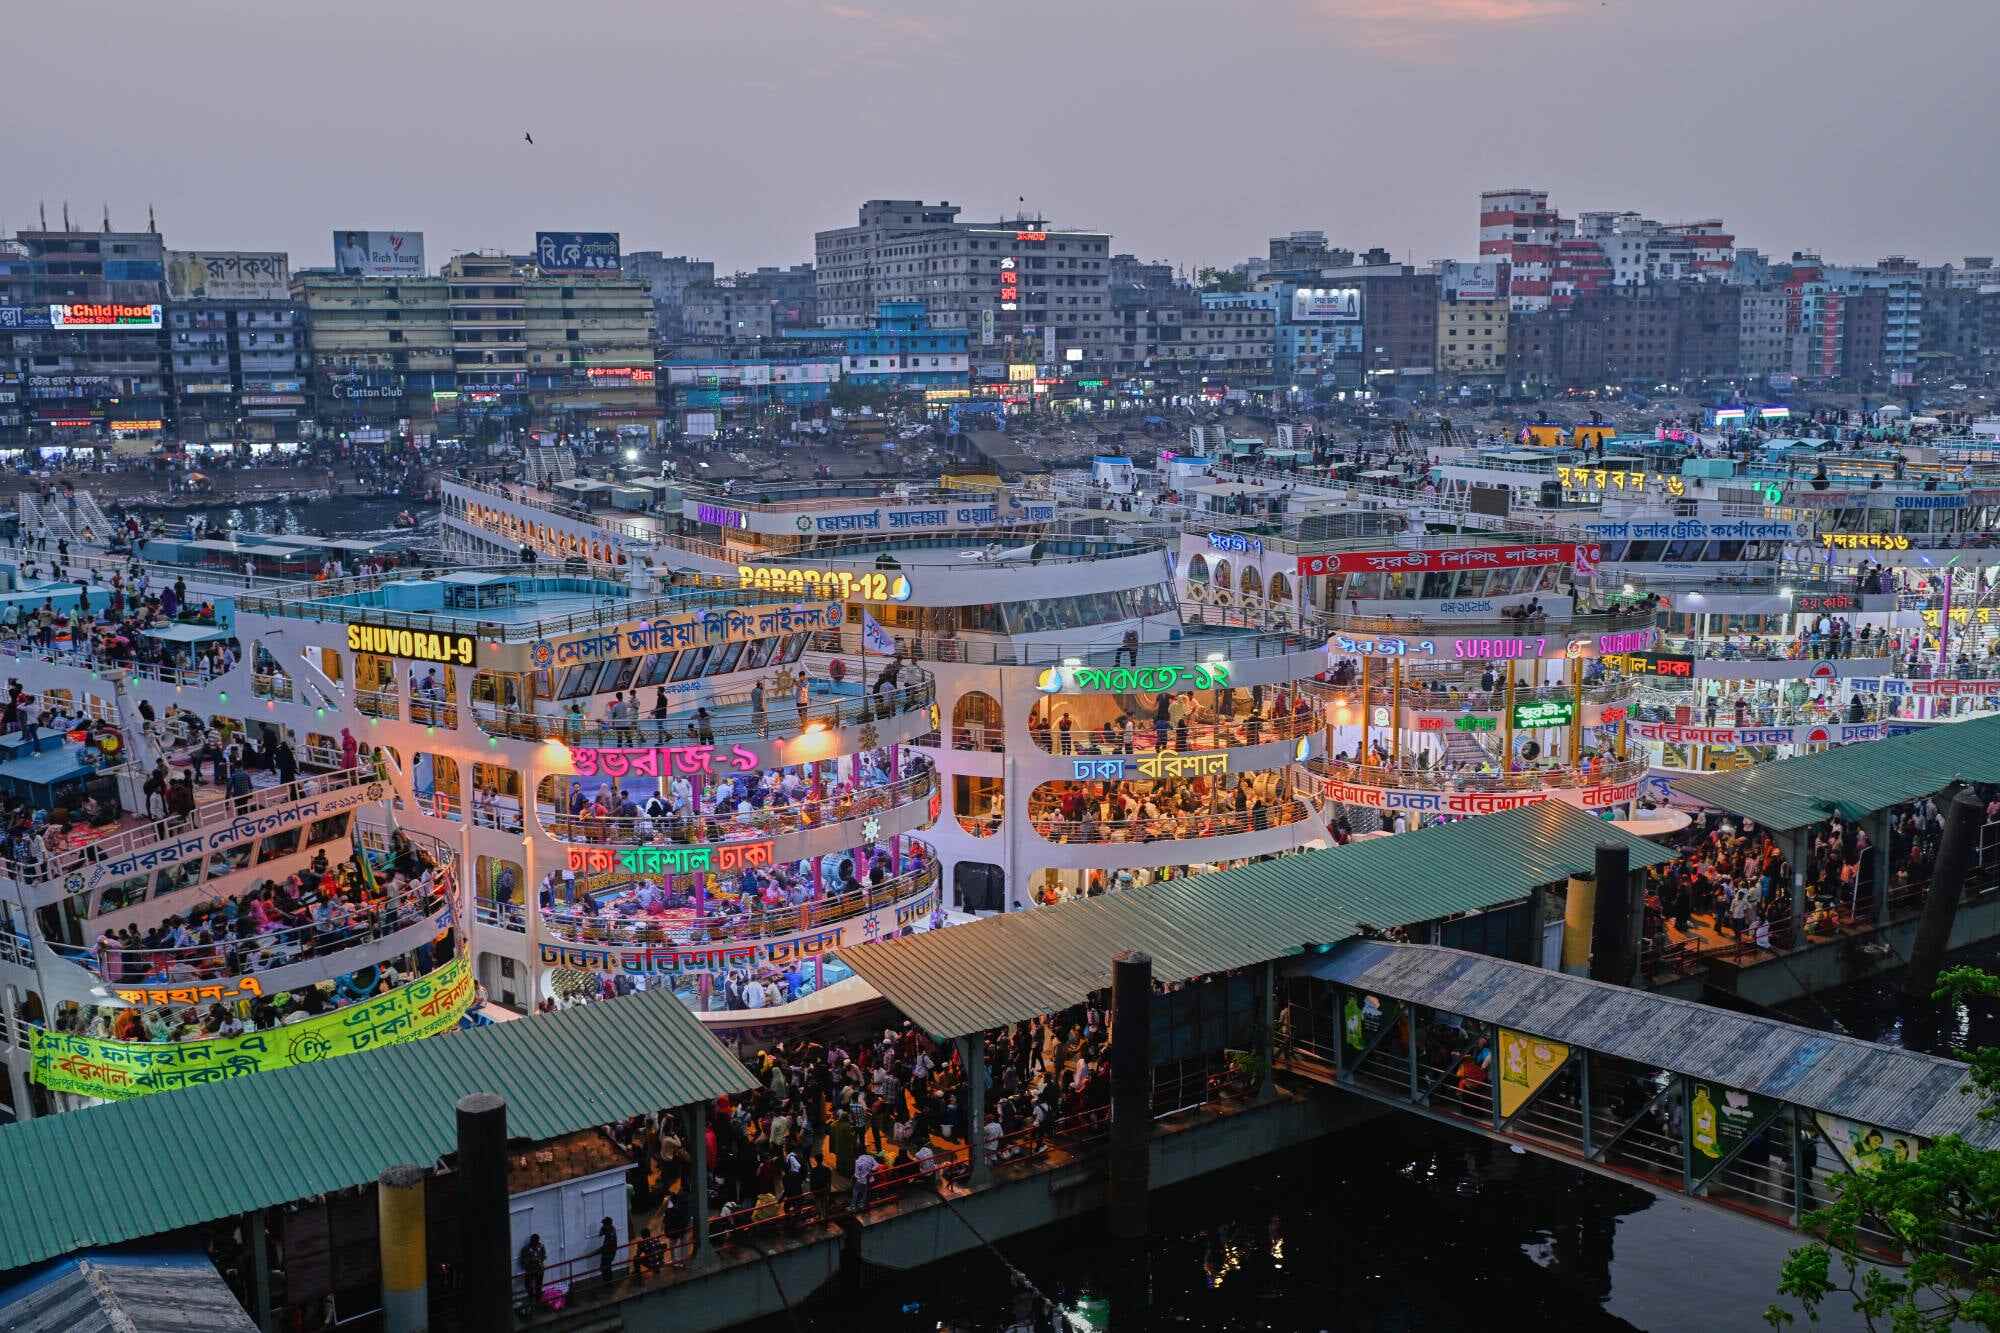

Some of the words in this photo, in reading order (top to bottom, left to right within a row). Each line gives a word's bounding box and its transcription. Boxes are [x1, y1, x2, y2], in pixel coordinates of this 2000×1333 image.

[206, 254, 283, 281] রূপকথা
[372, 251, 391, 264] Rich
[394, 254, 419, 265] Young
[64, 316, 94, 324] Choice
[73, 304, 112, 316] Child
[114, 305, 152, 316] Hood
[347, 388, 376, 397] Cotton
[381, 386, 402, 397] Club
[815, 507, 880, 533] মেসার্স
[888, 508, 948, 529] সালমা
[1633, 522, 1669, 538] ডলার
[1367, 553, 1429, 570] সুরভী
[1440, 550, 1496, 566] শিপিং
[738, 565, 888, 600] PARABAT-12
[348, 624, 473, 664] SHUVORAJ-9
[557, 627, 621, 662] মেসার্স
[627, 619, 697, 651] আম্বিয়া
[704, 608, 754, 642] শিপিং
[1073, 664, 1231, 693] পারাবত-১২
[571, 744, 758, 777] শুভরাজ-৯
[109, 837, 205, 876] ফারহান
[209, 802, 319, 849] নেভিগেশন
[114, 977, 265, 1004] ফারহান-৭
